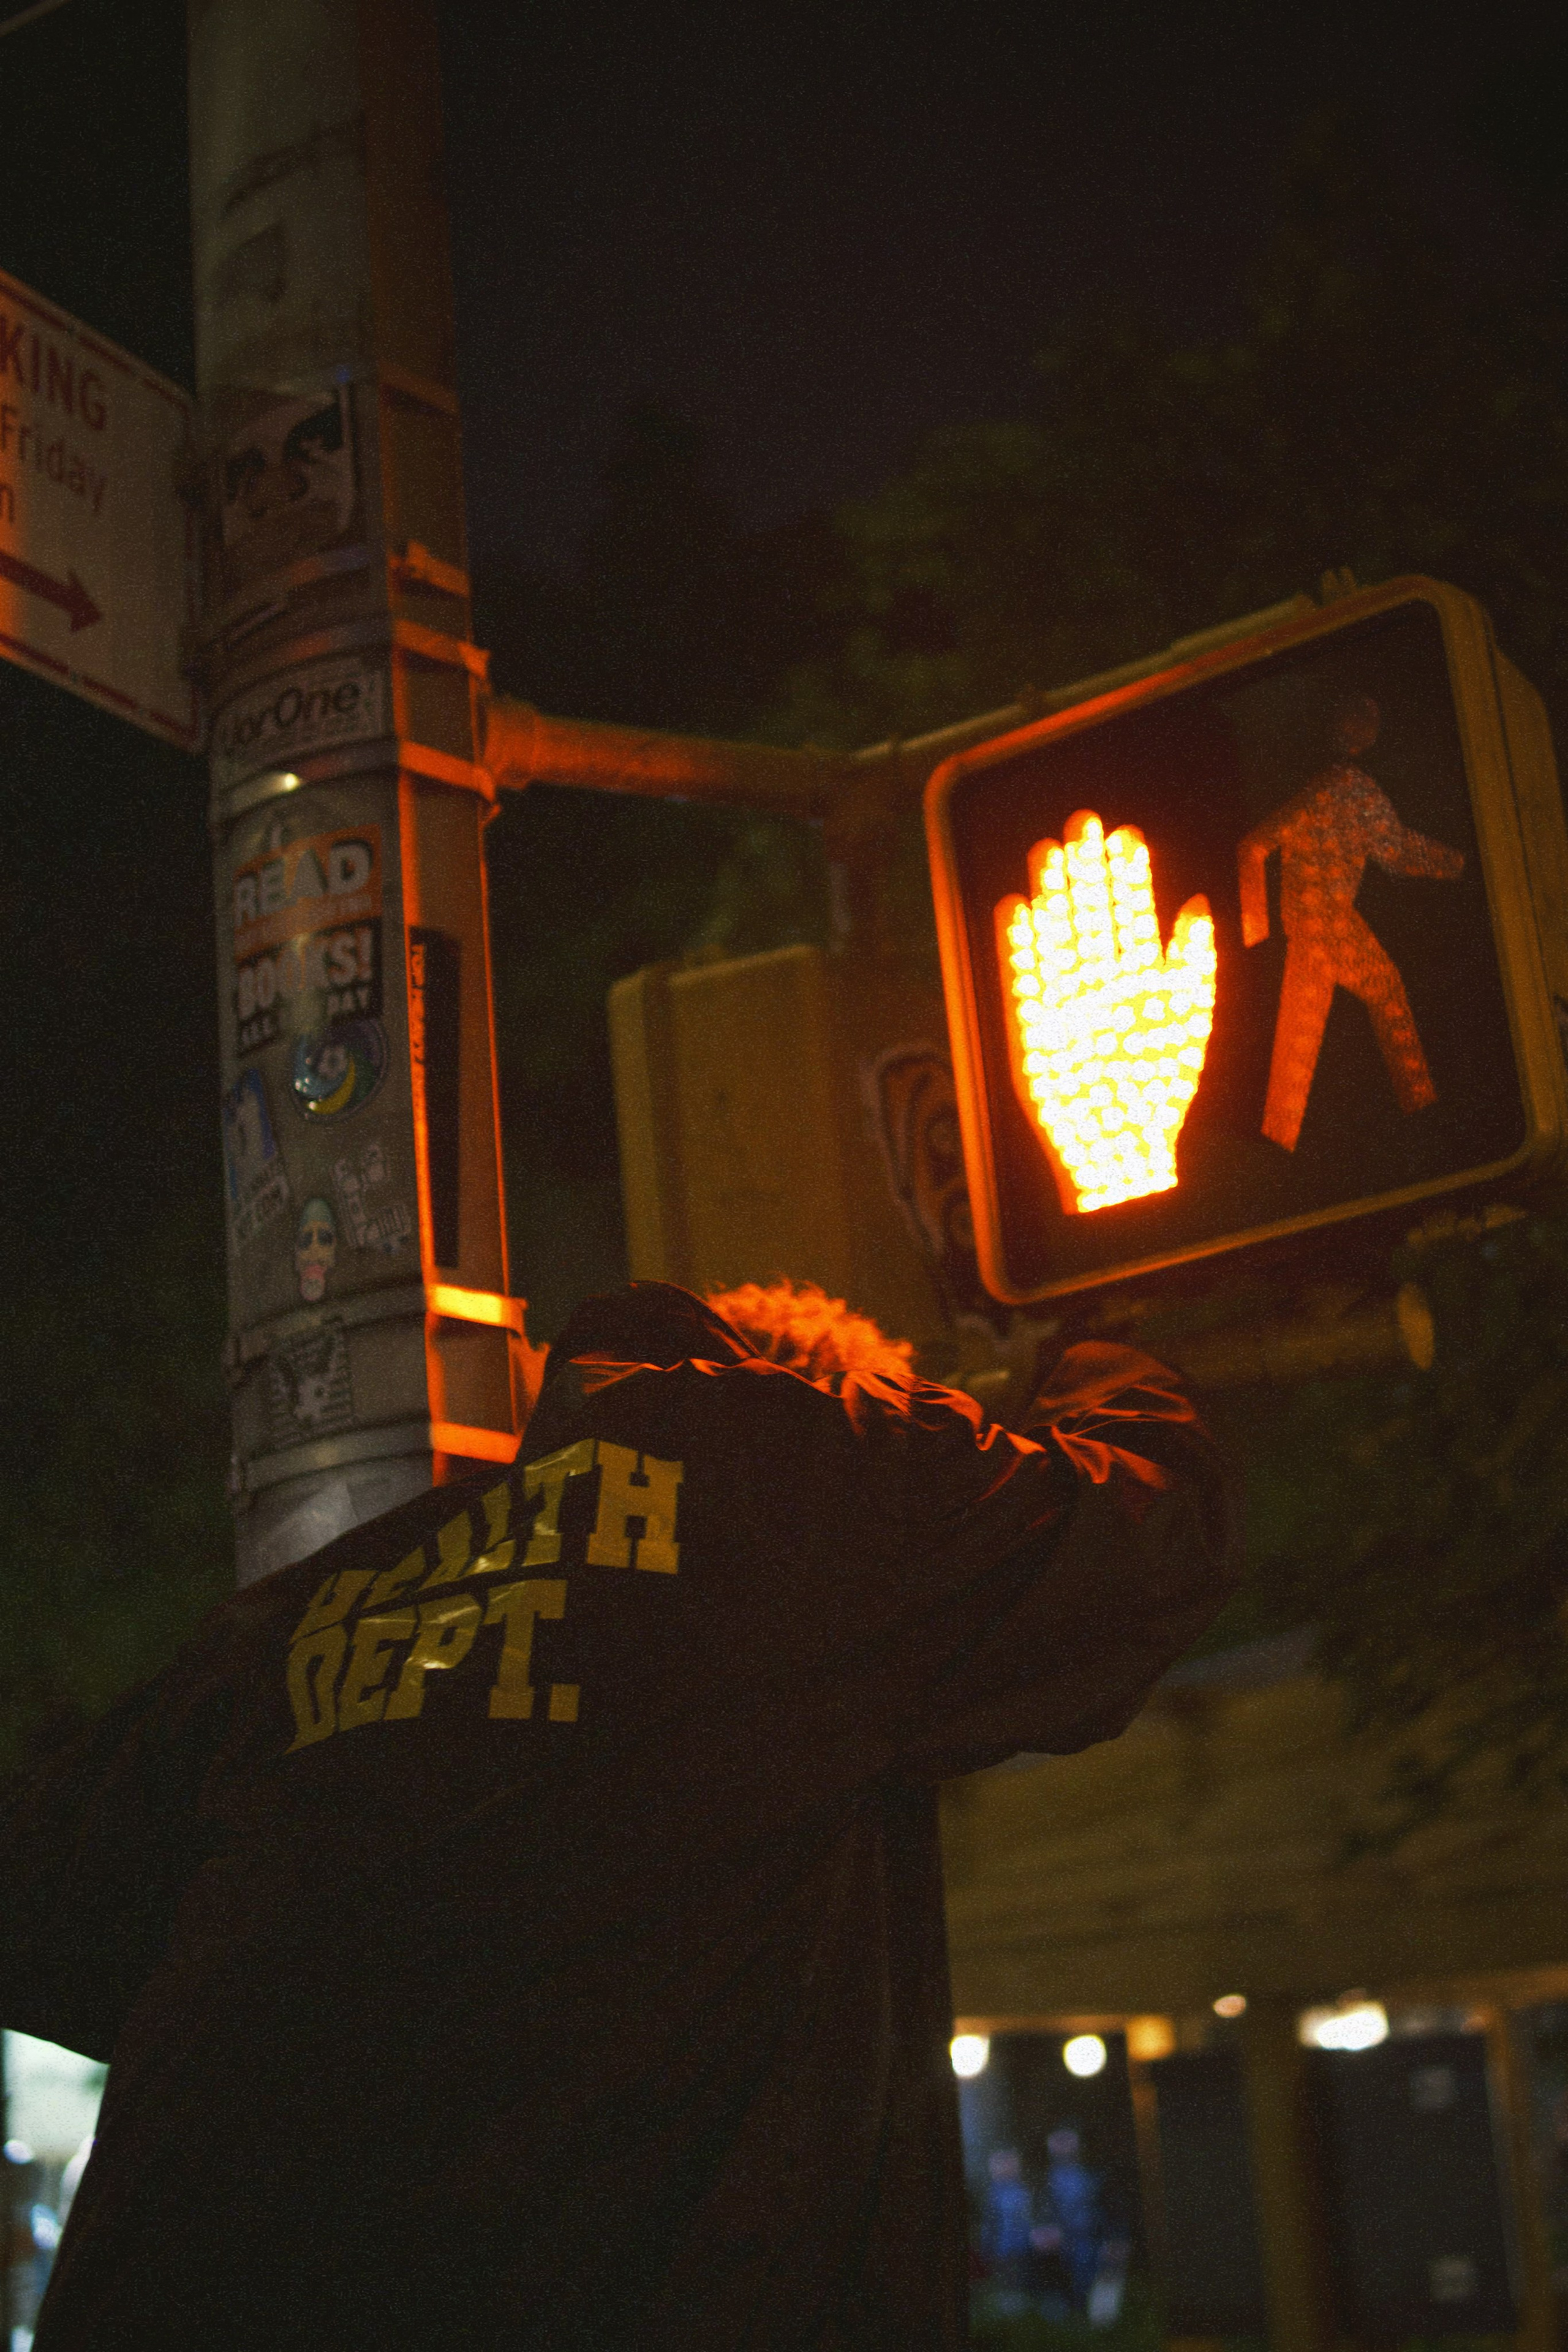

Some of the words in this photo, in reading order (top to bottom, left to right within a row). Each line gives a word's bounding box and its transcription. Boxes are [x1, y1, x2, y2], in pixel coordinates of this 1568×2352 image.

[0, 315, 106, 431] KING
[0, 404, 107, 514] Friday
[235, 841, 372, 927] READ
[289, 1438, 684, 1646] HEALTH
[284, 1579, 581, 1756] DEPT.
